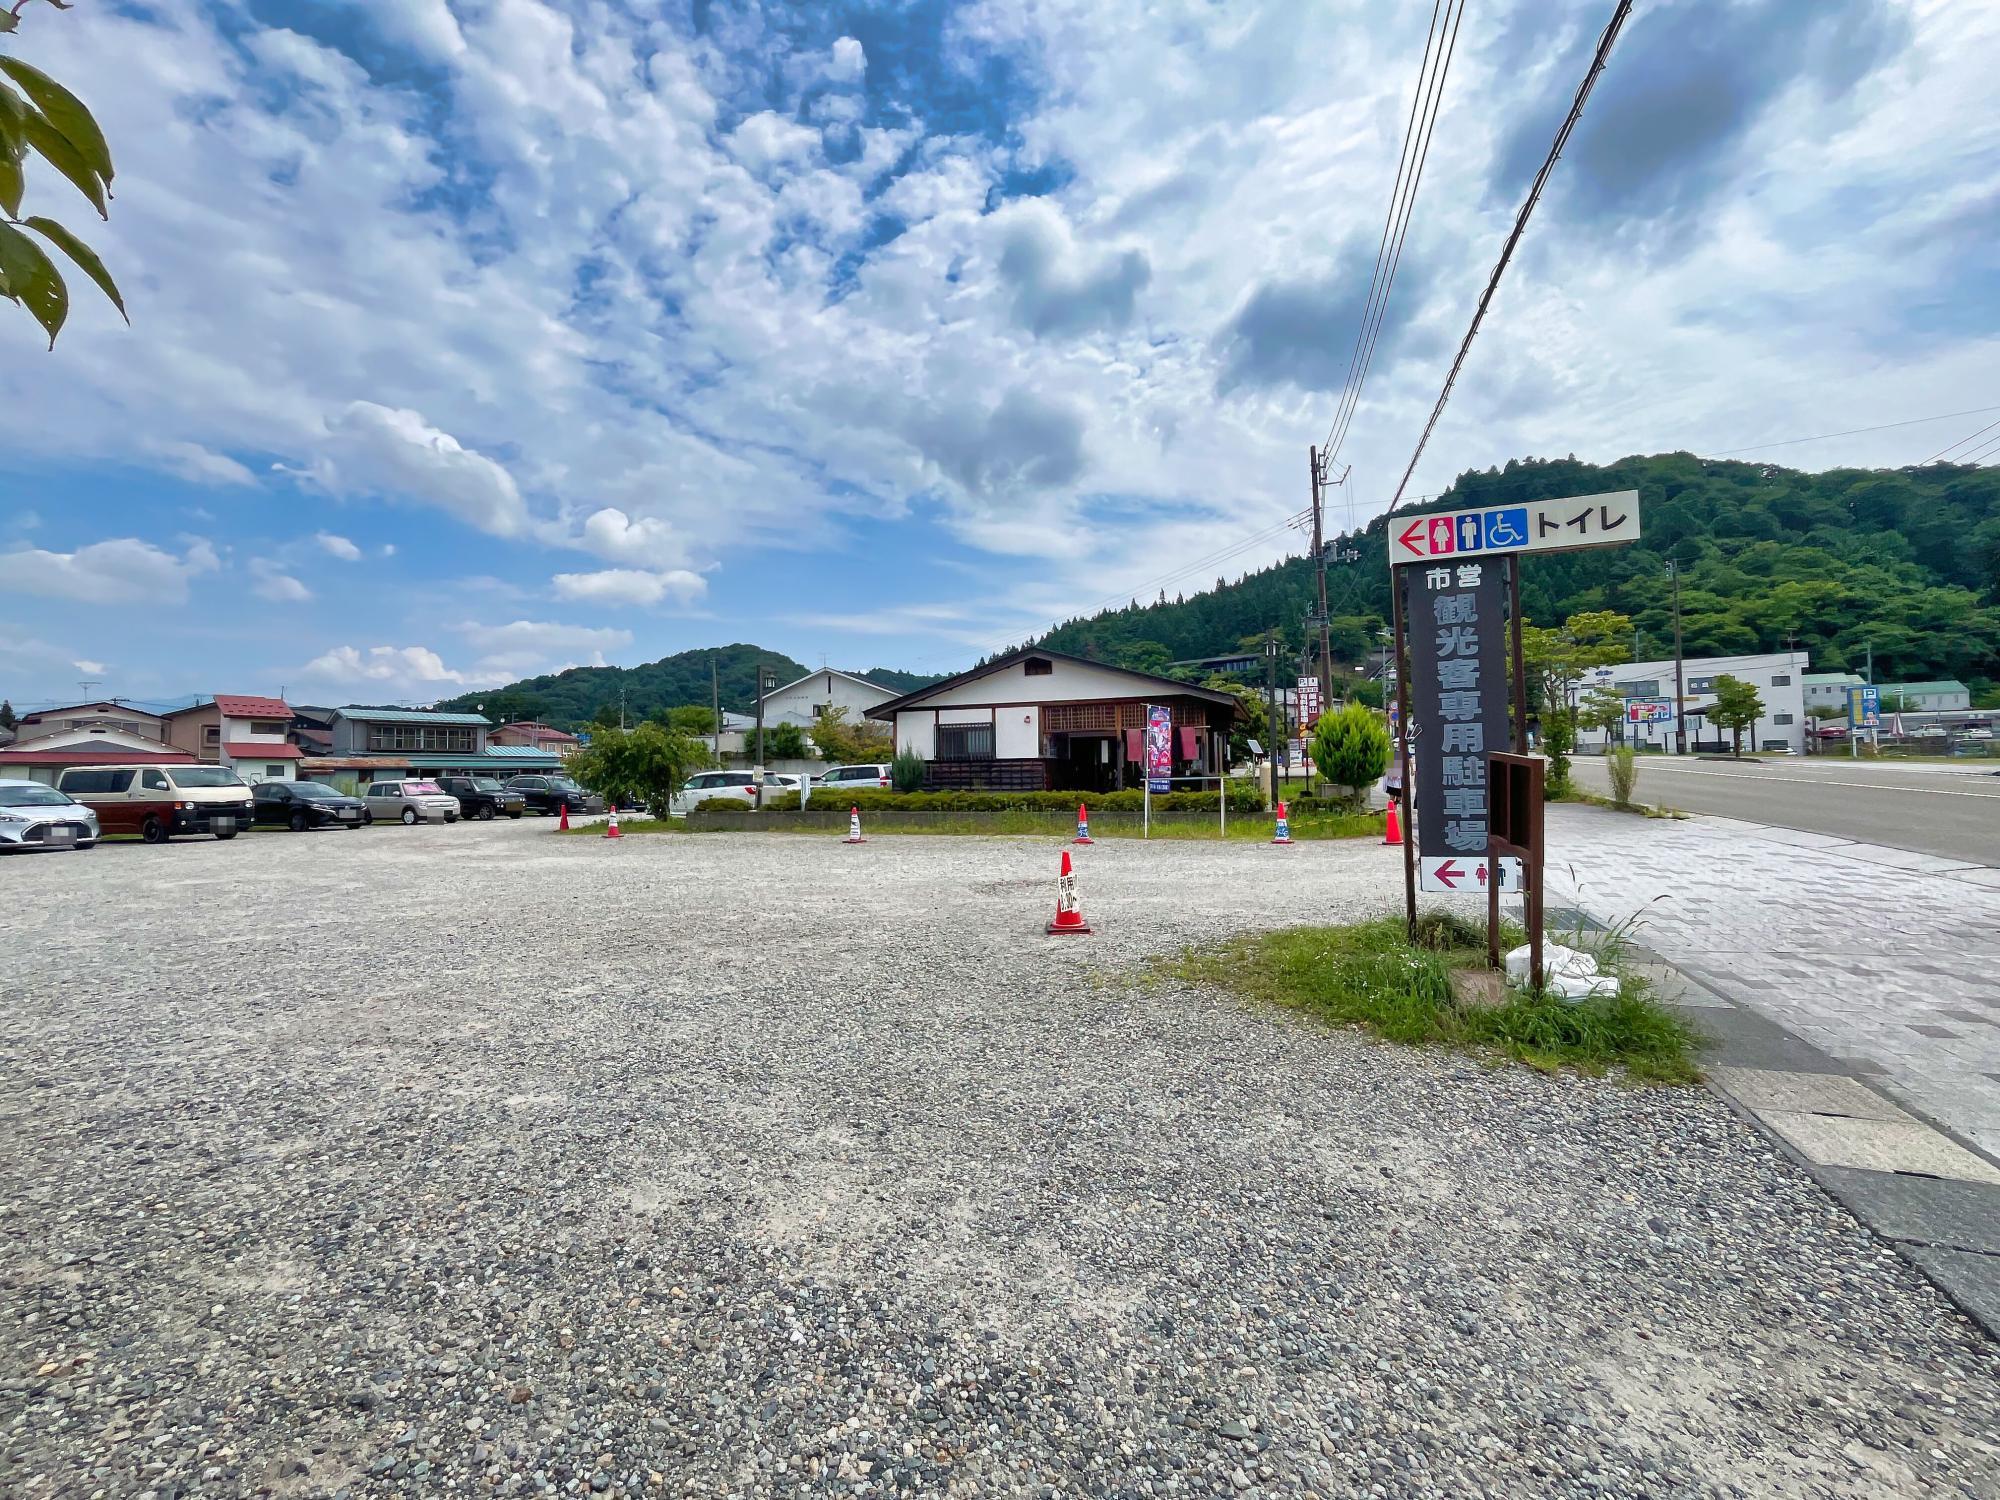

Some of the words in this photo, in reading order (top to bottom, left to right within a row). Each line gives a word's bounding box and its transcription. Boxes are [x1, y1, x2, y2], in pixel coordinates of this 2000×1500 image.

[1538, 505, 1627, 538] トイレ
[1425, 564, 1482, 590] 市営
[1433, 593, 1488, 851] 観光客専用駐車場
